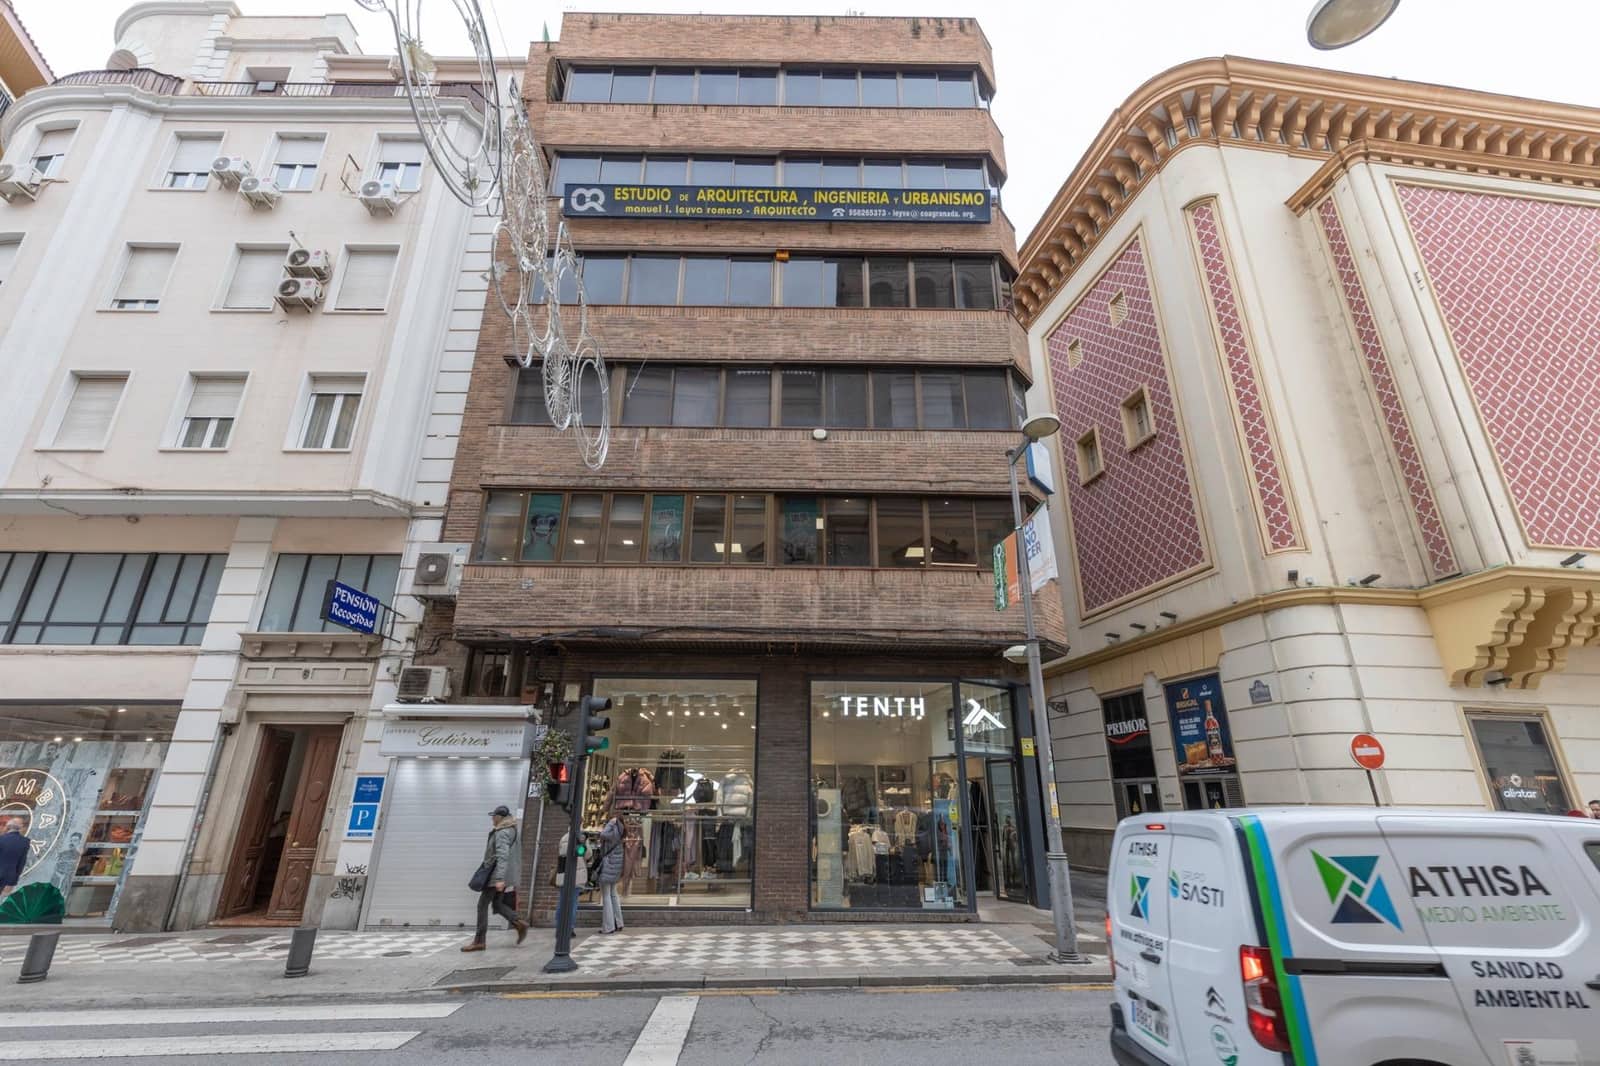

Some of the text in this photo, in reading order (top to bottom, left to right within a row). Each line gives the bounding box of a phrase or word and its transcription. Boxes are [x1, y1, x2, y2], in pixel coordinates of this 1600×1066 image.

[614, 187, 671, 201] ESTUDIO
[814, 191, 889, 205] INGENIERIA
[902, 191, 985, 206] URBANISMO
[625, 205, 661, 214] manuel
[675, 205, 703, 216] leyva
[707, 207, 742, 215] romero
[754, 206, 817, 217] ARQUITECTO
[335, 586, 377, 614] PENSIÓN
[331, 602, 374, 629] Recogidas
[840, 696, 925, 717] TENTH
[417, 726, 491, 747] Gutiérrez
[1106, 718, 1148, 736] PRIMOR
[357, 809, 370, 826] P
[1128, 842, 1158, 857] ATHISA
[1408, 865, 1552, 898] ATHISA
[1181, 882, 1225, 908] SASTI
[1416, 904, 1567, 923] MEDIO AMBIENTE
[1470, 960, 1564, 980] SANIDAD
[1473, 989, 1592, 1009] AMBIENTAL
